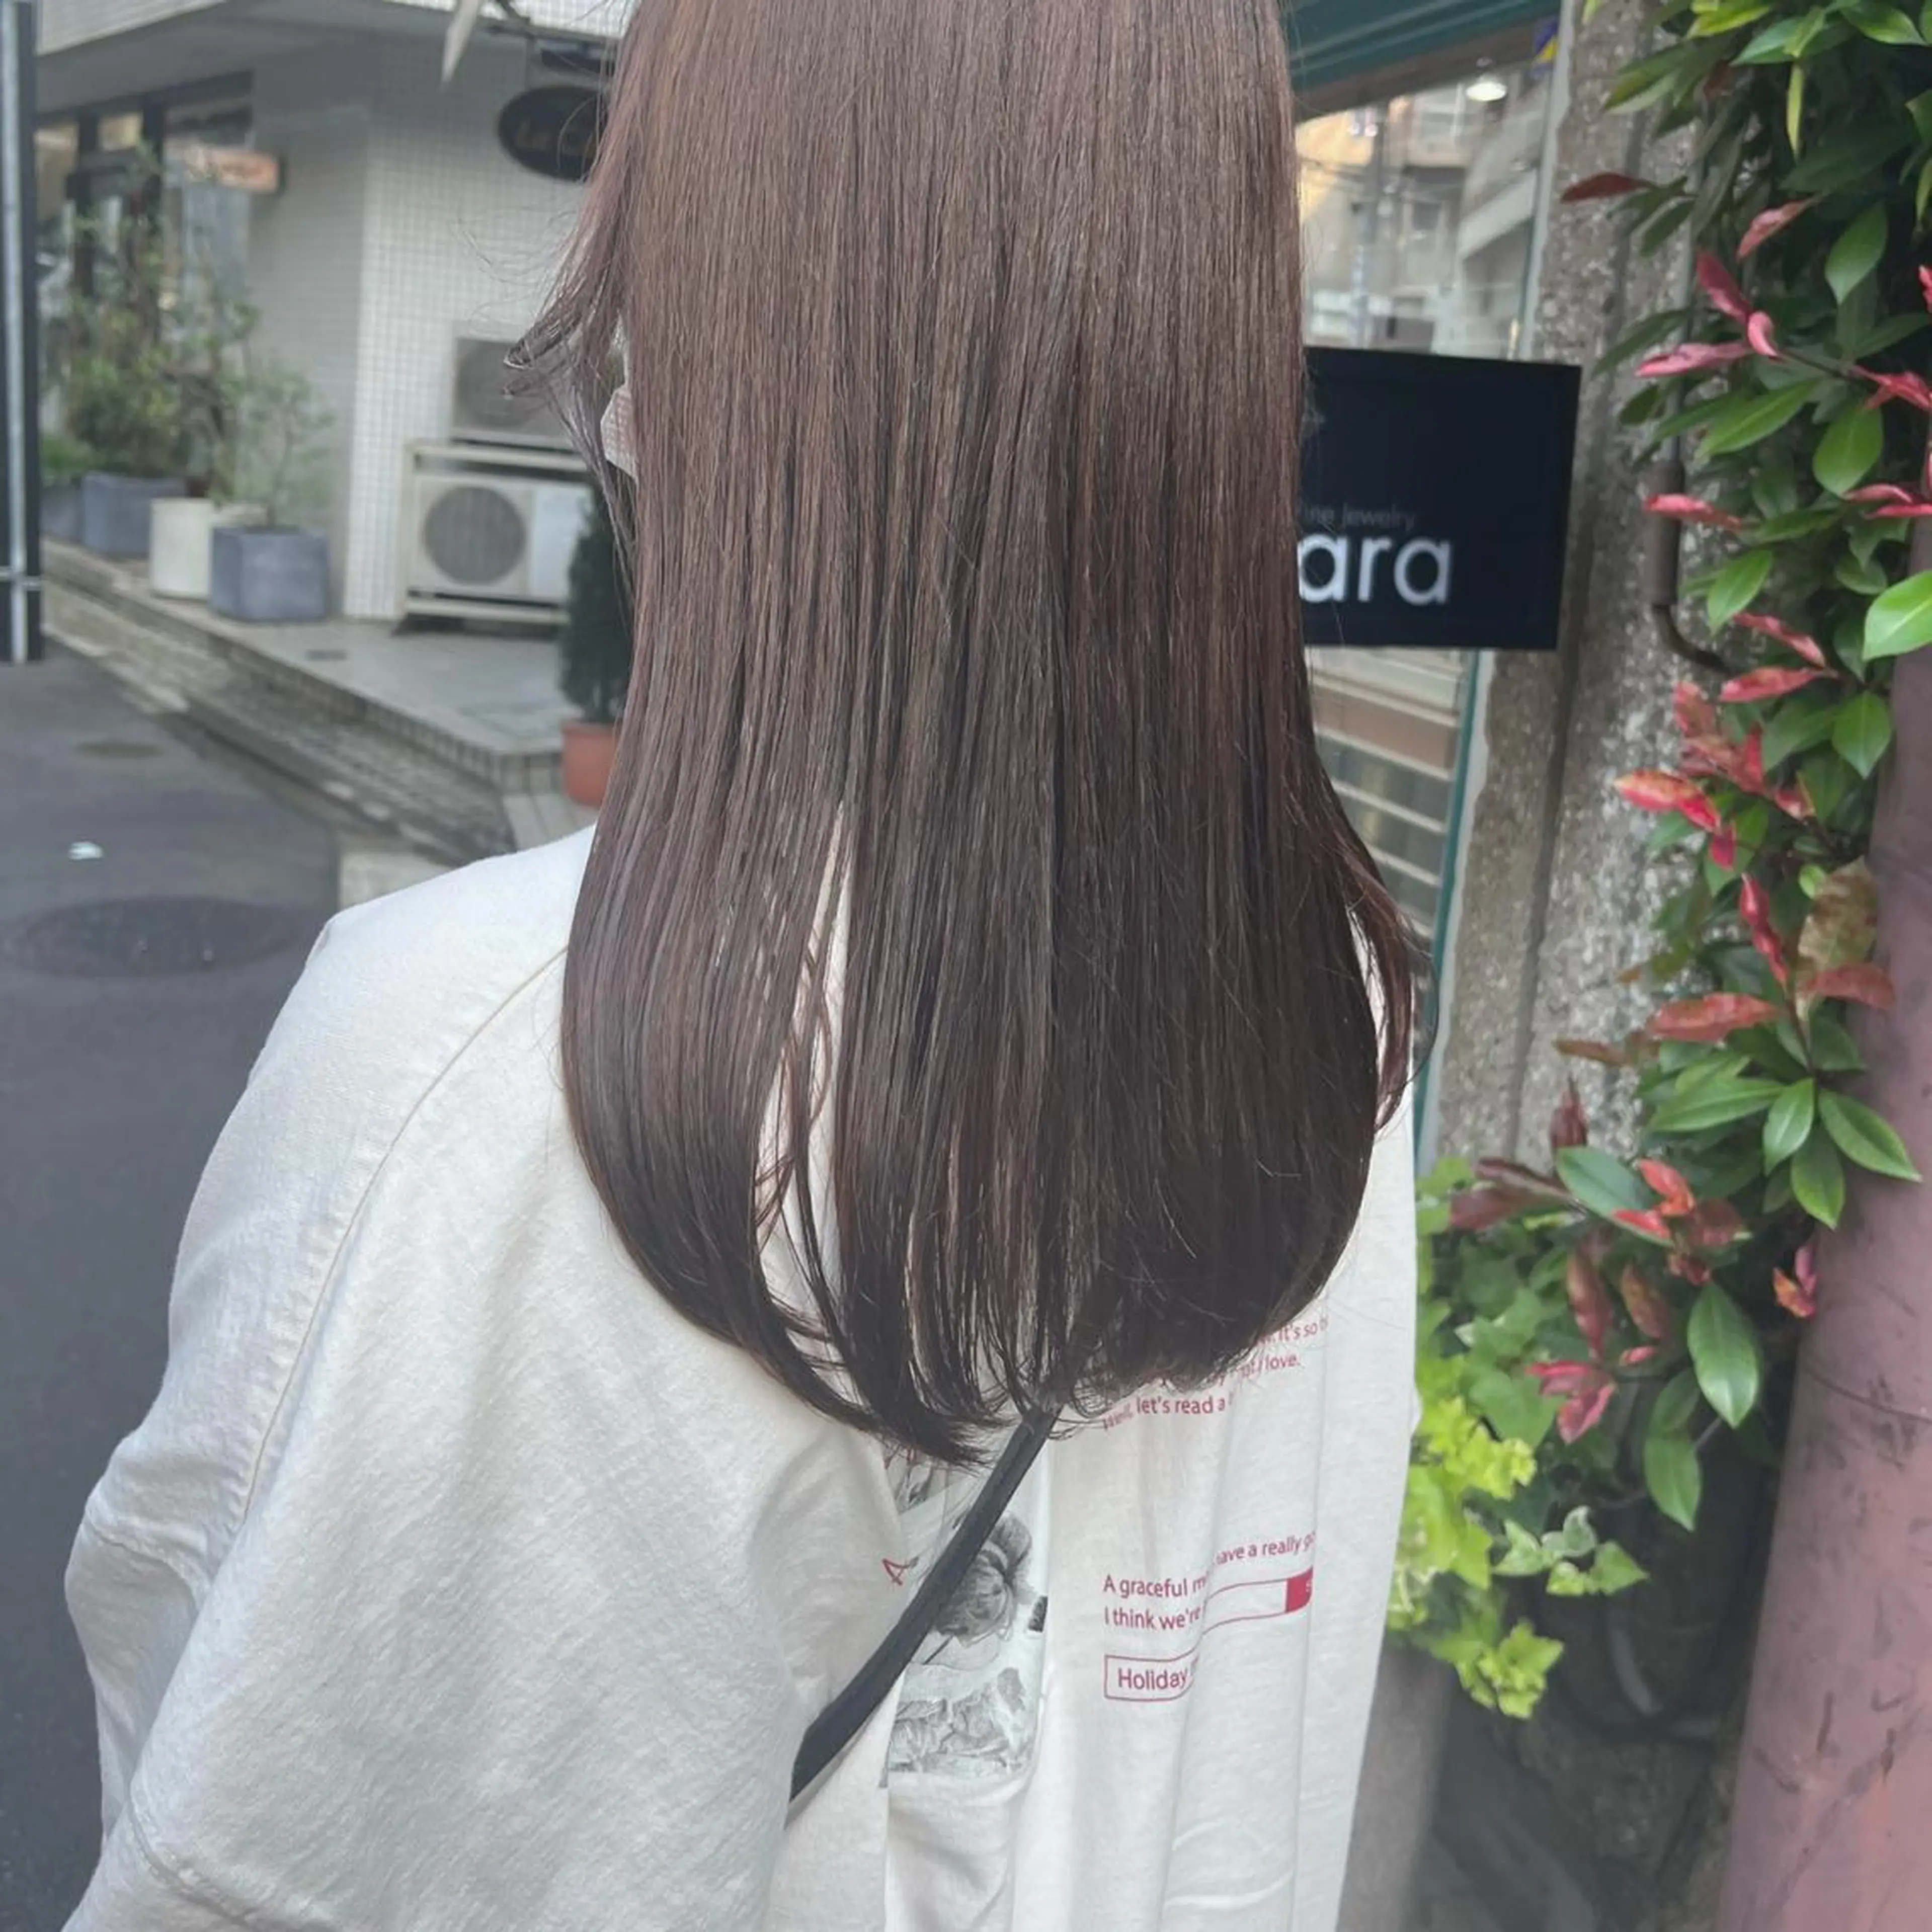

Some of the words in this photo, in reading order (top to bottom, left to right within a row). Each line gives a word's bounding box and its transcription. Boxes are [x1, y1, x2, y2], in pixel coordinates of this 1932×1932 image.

[1136, 1396, 1171, 1415] let's
[1174, 1395, 1214, 1415] read
[1217, 1397, 1226, 1411] a
[1103, 1573, 1116, 1593] A
[1119, 1578, 1187, 1599] graceful
[1216, 1546, 1245, 1565] ave
[1248, 1544, 1257, 1557] a
[1262, 1535, 1302, 1556] really
[1104, 1605, 1109, 1625] I
[1112, 1607, 1157, 1630] think
[1118, 1667, 1188, 1690] Holiday
